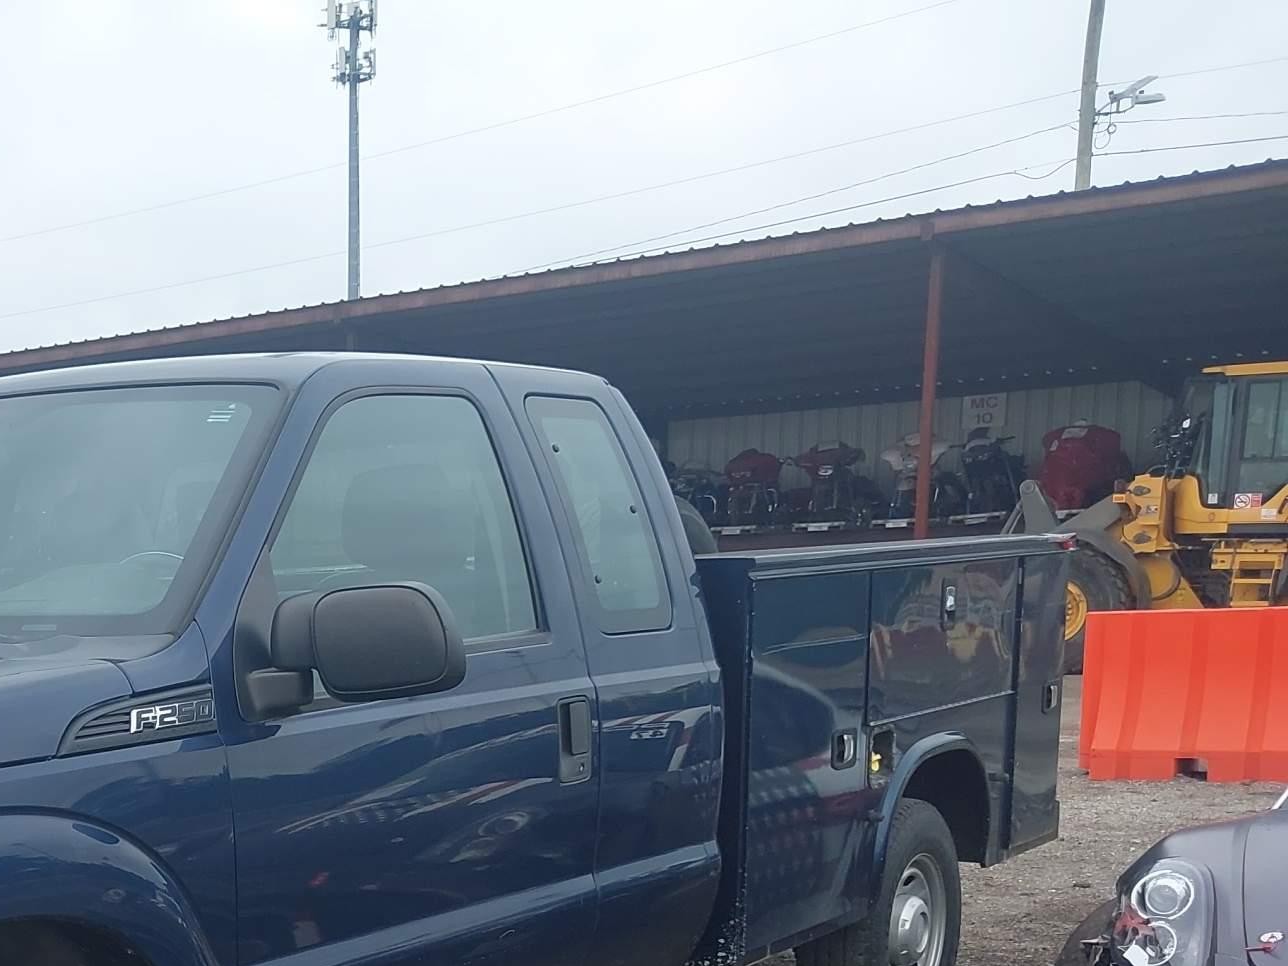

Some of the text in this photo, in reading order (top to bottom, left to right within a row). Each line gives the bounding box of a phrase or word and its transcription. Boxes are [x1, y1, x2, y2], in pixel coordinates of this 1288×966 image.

[970, 397, 998, 409] MC
[977, 413, 993, 425] 10
[130, 699, 214, 734] F-250
